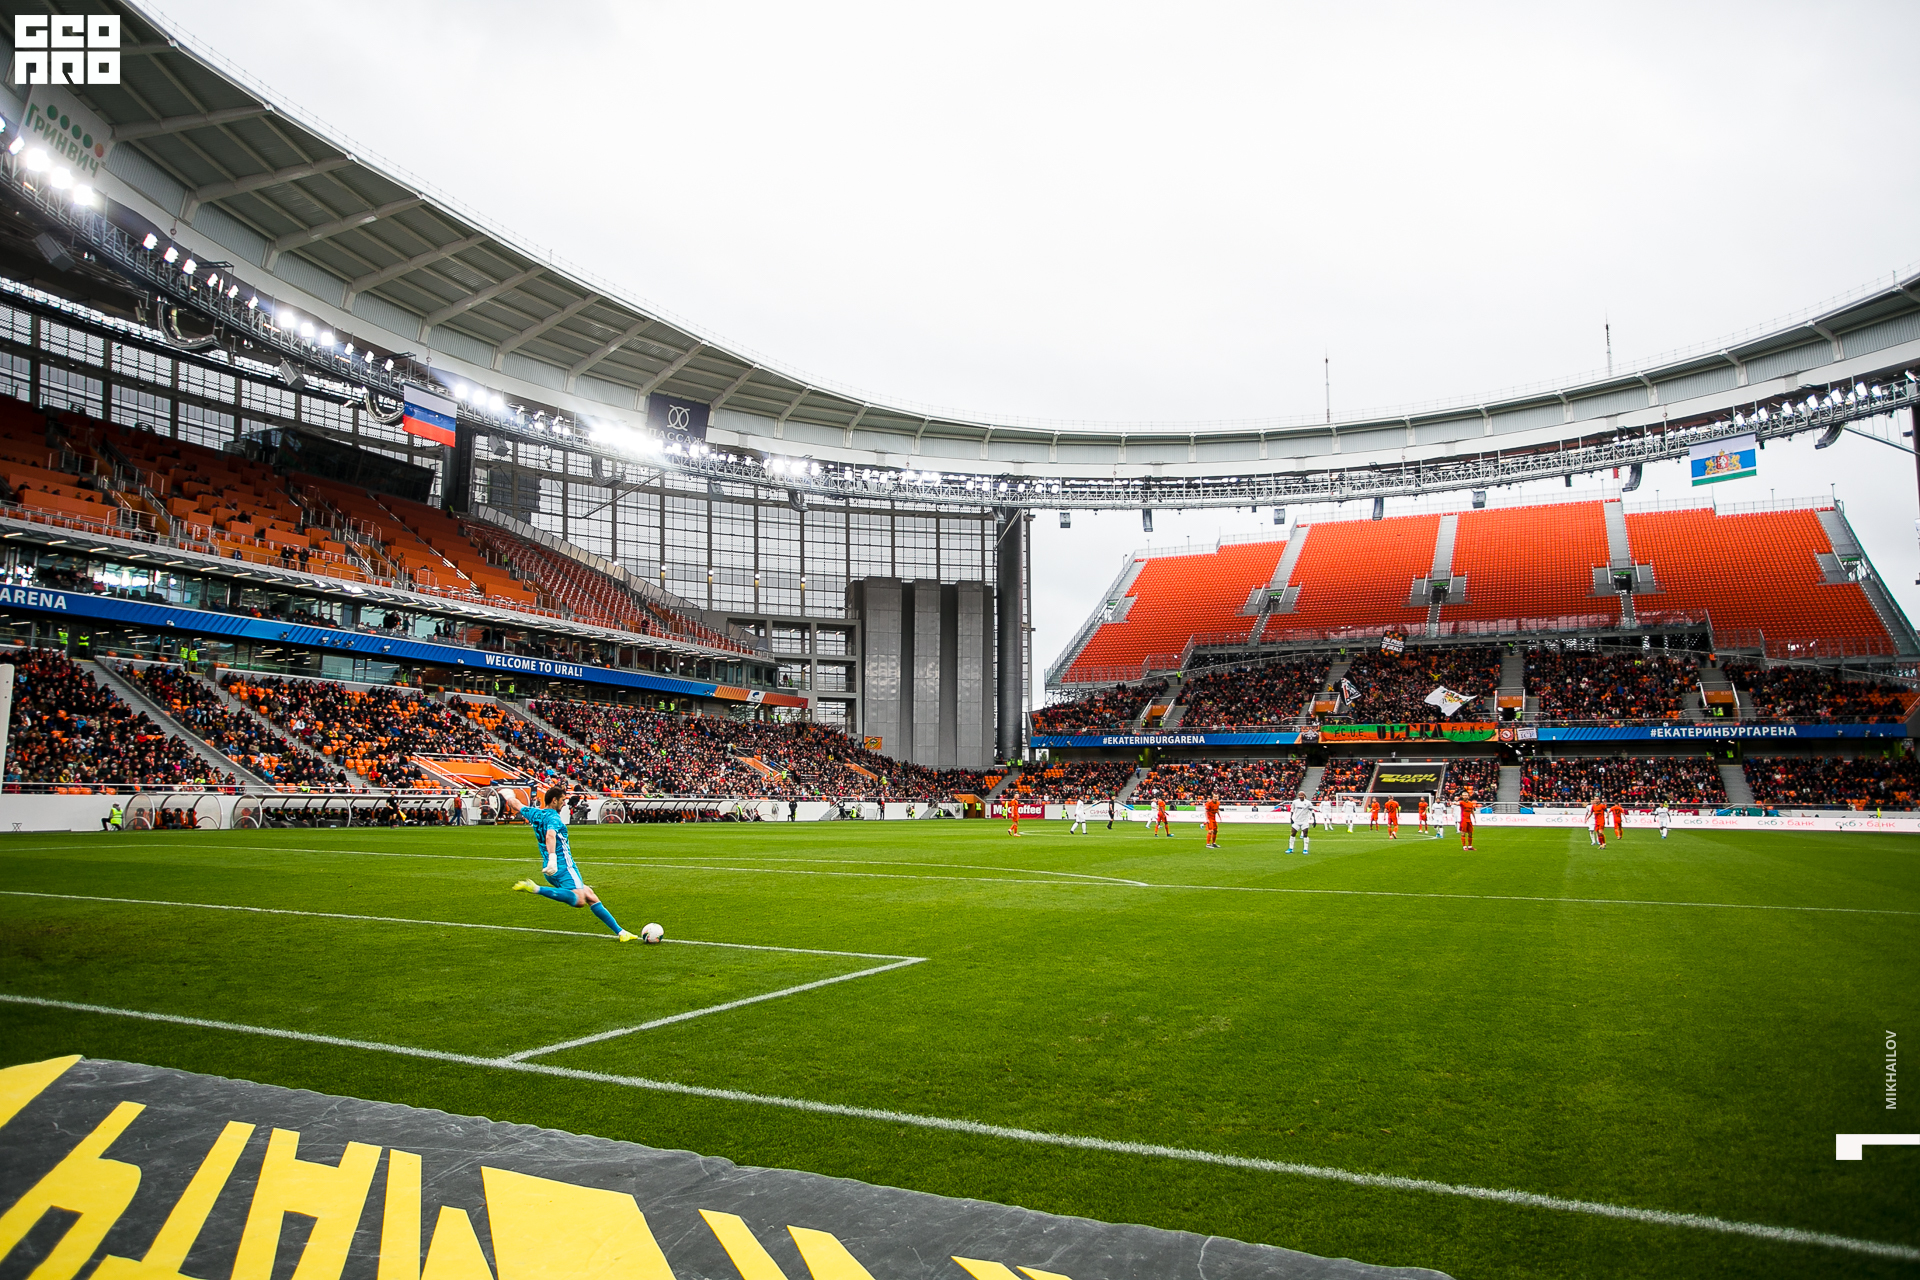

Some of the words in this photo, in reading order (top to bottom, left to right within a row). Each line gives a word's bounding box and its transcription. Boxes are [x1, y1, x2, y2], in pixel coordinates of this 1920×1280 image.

[648, 427, 704, 446] ПАССАЖ
[0, 587, 67, 610] ARENA
[485, 654, 537, 671] WELCOME
[539, 661, 552, 673] TO
[555, 664, 583, 677] URAL!
[1451, 725, 1483, 735] FANS
[1650, 726, 1797, 738] #ЕКАТЕРИНБУРГАРЕНА
[1102, 735, 1205, 745] #EKATERINBURGARENA
[1711, 818, 1738, 826] банк
[1757, 818, 1777, 826] скб
[1787, 819, 1814, 827] банк
[1835, 820, 1856, 828] скб
[1866, 820, 1896, 828] банк
